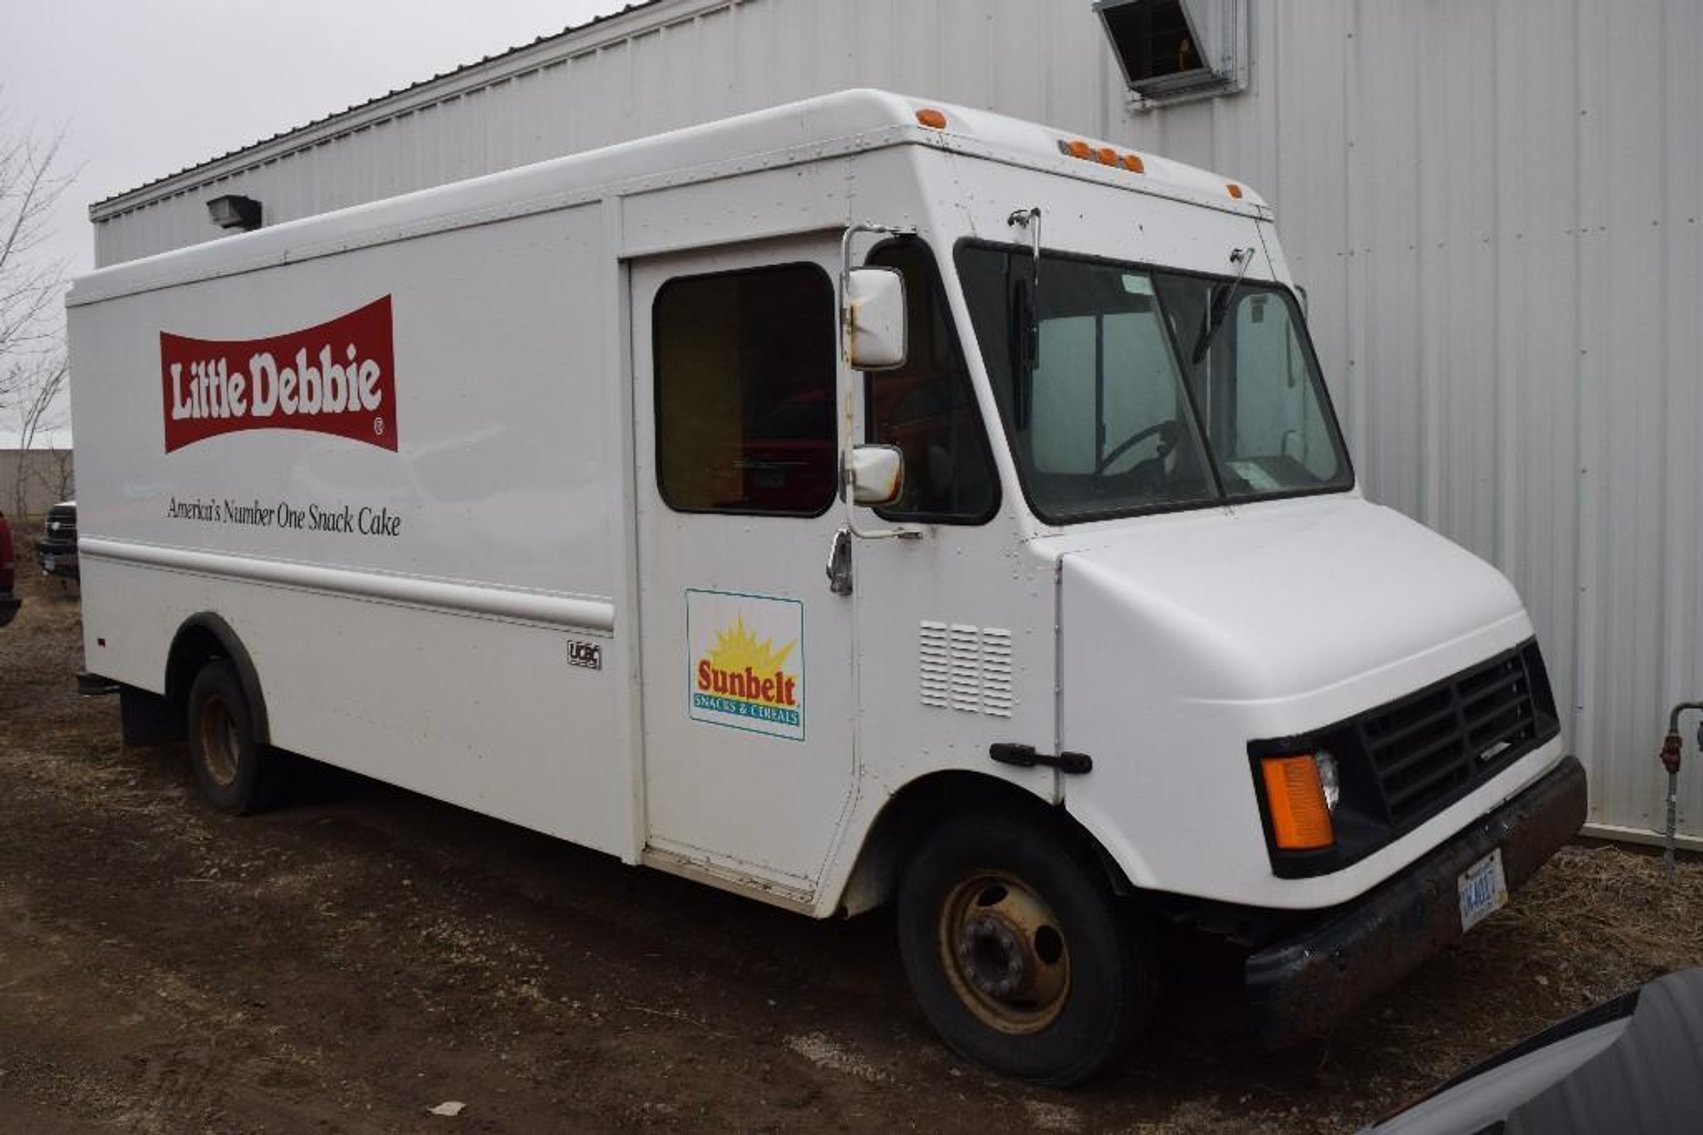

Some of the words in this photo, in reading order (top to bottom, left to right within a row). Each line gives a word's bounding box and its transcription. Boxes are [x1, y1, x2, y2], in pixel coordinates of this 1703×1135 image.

[170, 356, 247, 420] Little
[250, 343, 382, 417] Debbie
[168, 497, 221, 521] America's
[223, 499, 275, 527] Number
[277, 501, 306, 529] One
[308, 503, 354, 533] Snack
[358, 506, 401, 536] Cake
[697, 660, 796, 706] Sunbelt
[694, 695, 736, 712] SNACKS
[739, 703, 748, 714] &
[751, 705, 798, 724] CEREALS
